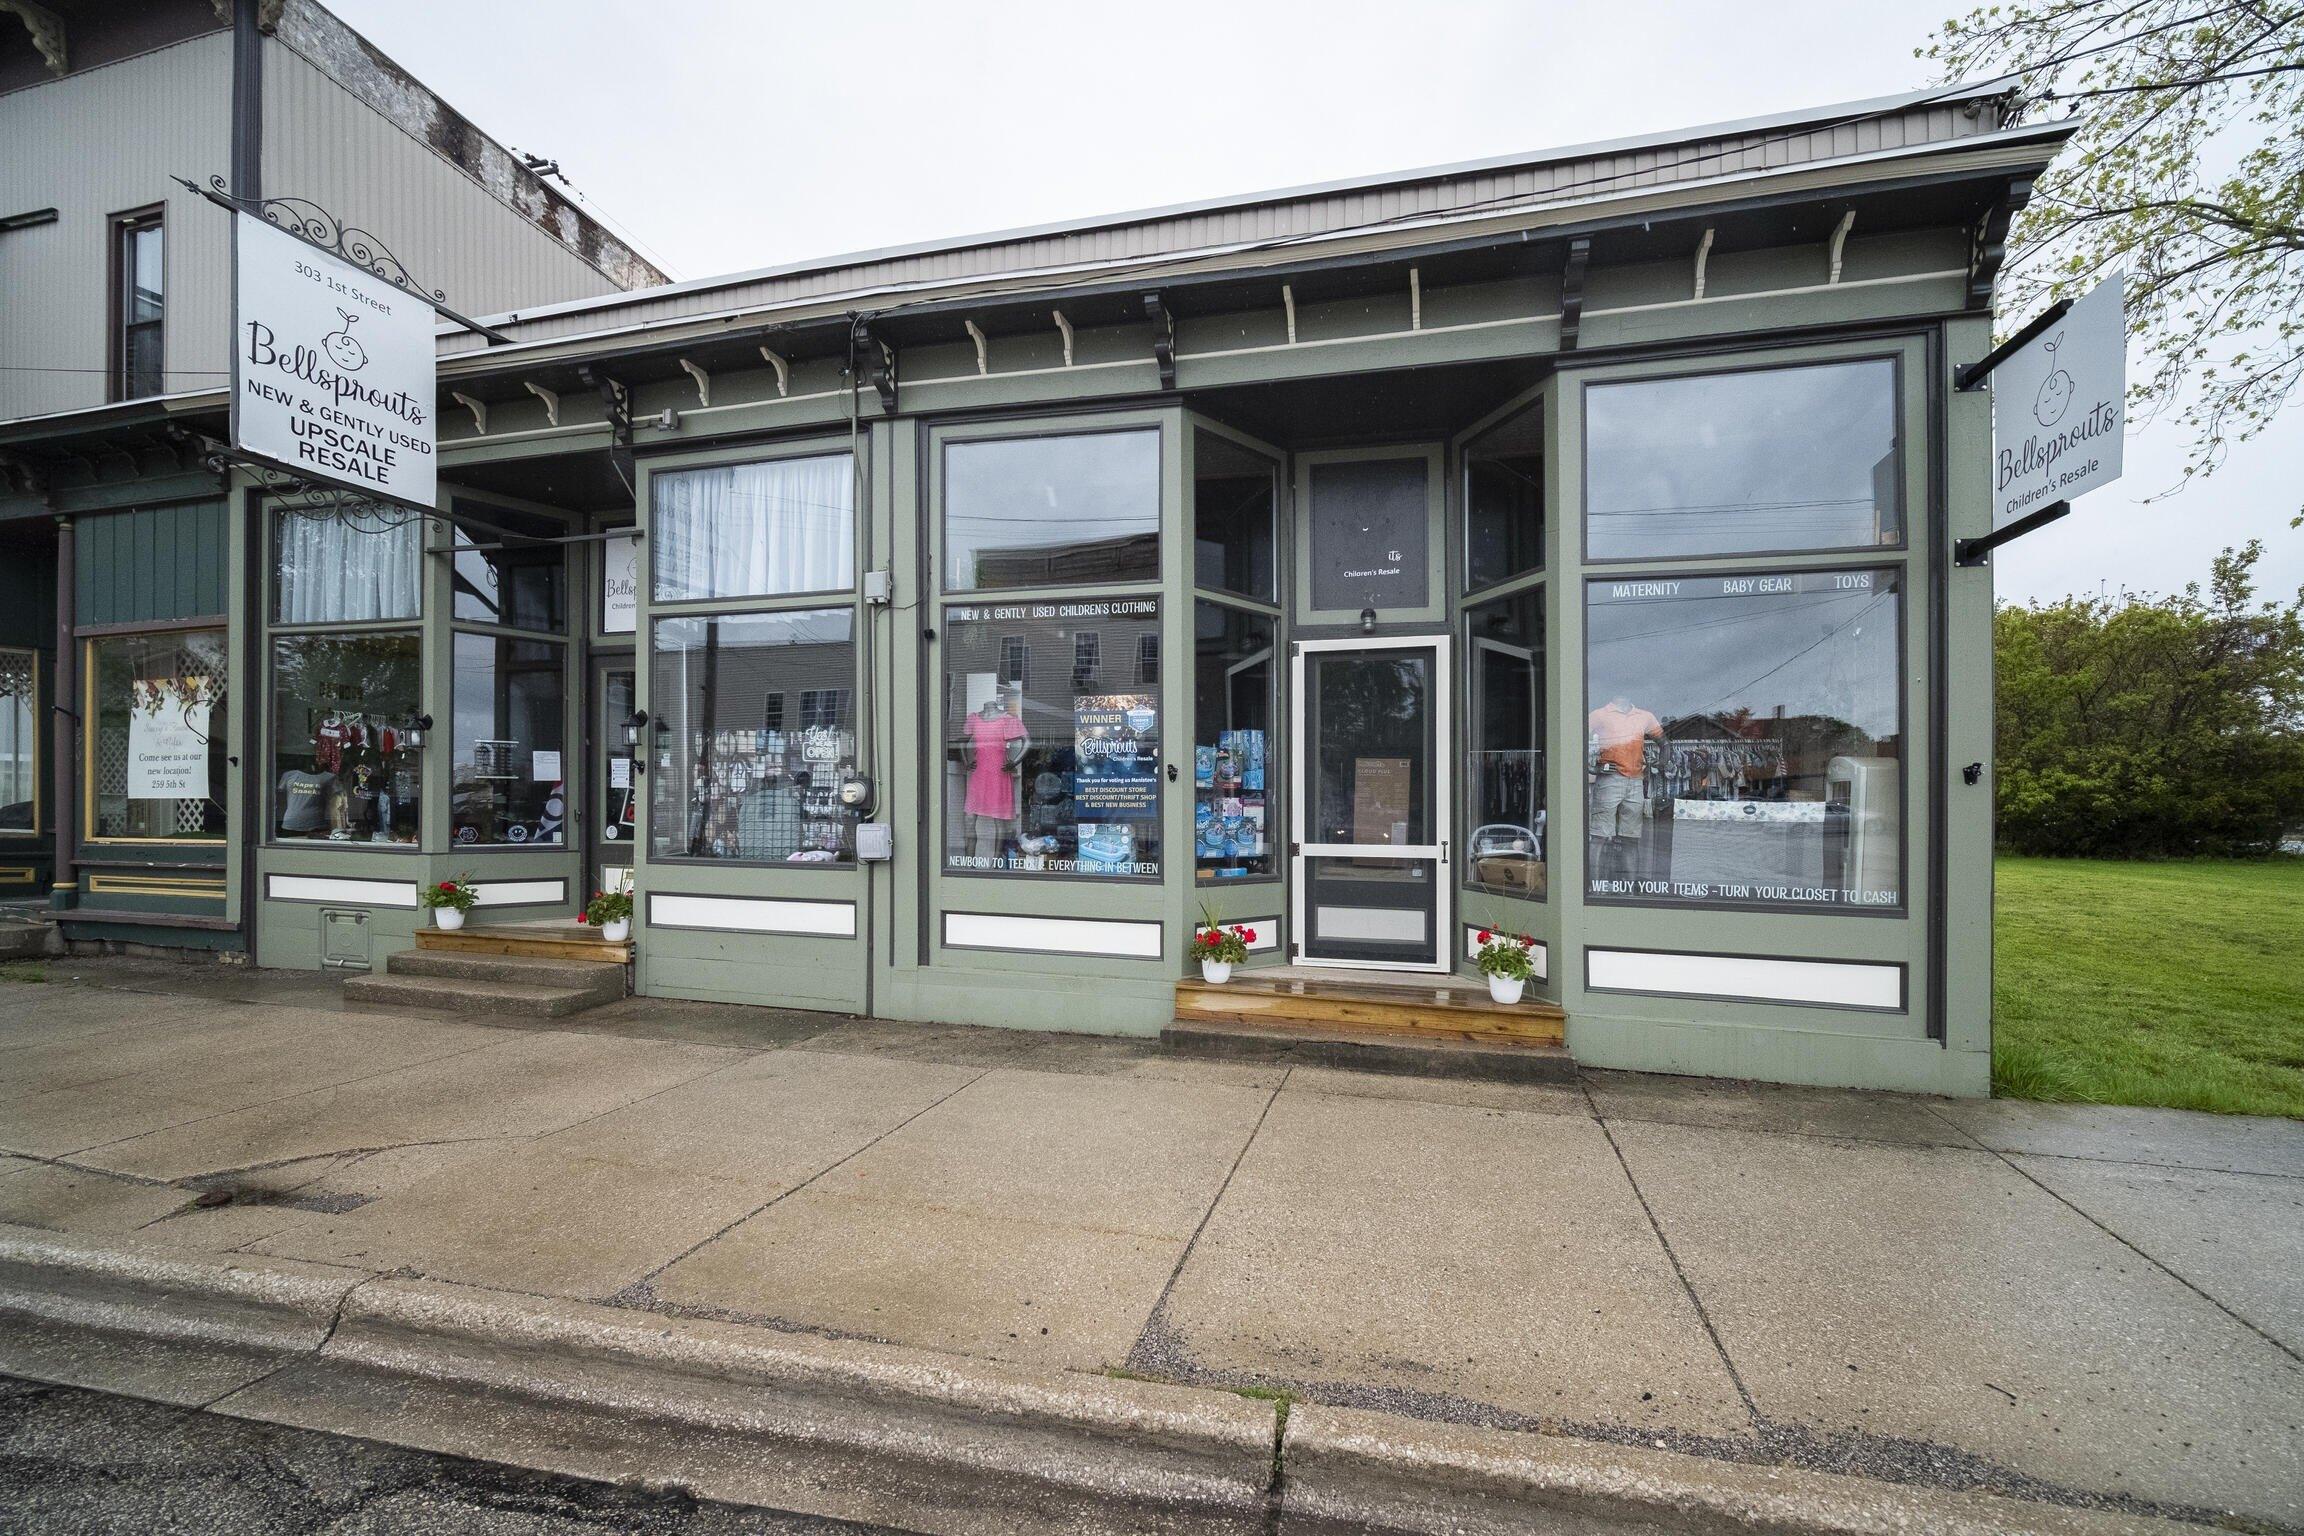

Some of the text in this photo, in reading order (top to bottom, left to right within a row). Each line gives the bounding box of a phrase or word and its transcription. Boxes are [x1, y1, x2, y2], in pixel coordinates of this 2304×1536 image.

[294, 261, 392, 316] 303 1st Street
[247, 320, 427, 426] Bellsprouts
[248, 379, 432, 455] NEW & GENTLY USED
[290, 416, 397, 467] UPSCALE
[1998, 401, 2119, 492] Bellsprouts
[299, 441, 389, 484] RESALE
[2006, 459, 2099, 514] Children's Resale
[1378, 567, 1400, 575] Resale
[1612, 582, 1681, 598] MATERNITY
[1723, 578, 1792, 594] BABY GEAR
[1834, 574, 1869, 589] TOYS
[960, 601, 1156, 621] NEW & GENTLY USED CHILDREN'S CLOTHING
[1080, 714, 1122, 724] WINNER
[138, 753, 159, 762] Come
[189, 753, 202, 761] our
[806, 746, 835, 758] OPEN
[1080, 738, 1138, 758] Bellsprouts
[163, 766, 192, 777] location!
[151, 780, 186, 789] 259 5th St
[949, 855, 989, 868] NEWBORN
[992, 857, 1004, 869] TO
[1048, 860, 1101, 872] EVERYTHING
[1105, 861, 1114, 873] IN
[1117, 862, 1159, 875] BETWEEN
[1592, 880, 1609, 892] WE
[1612, 880, 1635, 893] BUY
[1637, 881, 1669, 894] YOUR
[1673, 882, 1709, 896] ITEMS
[1755, 886, 1788, 899] YOUR
[1791, 887, 1836, 902] CLOSET
[1841, 889, 1857, 903] TO
[1863, 890, 1898, 904] CASH
